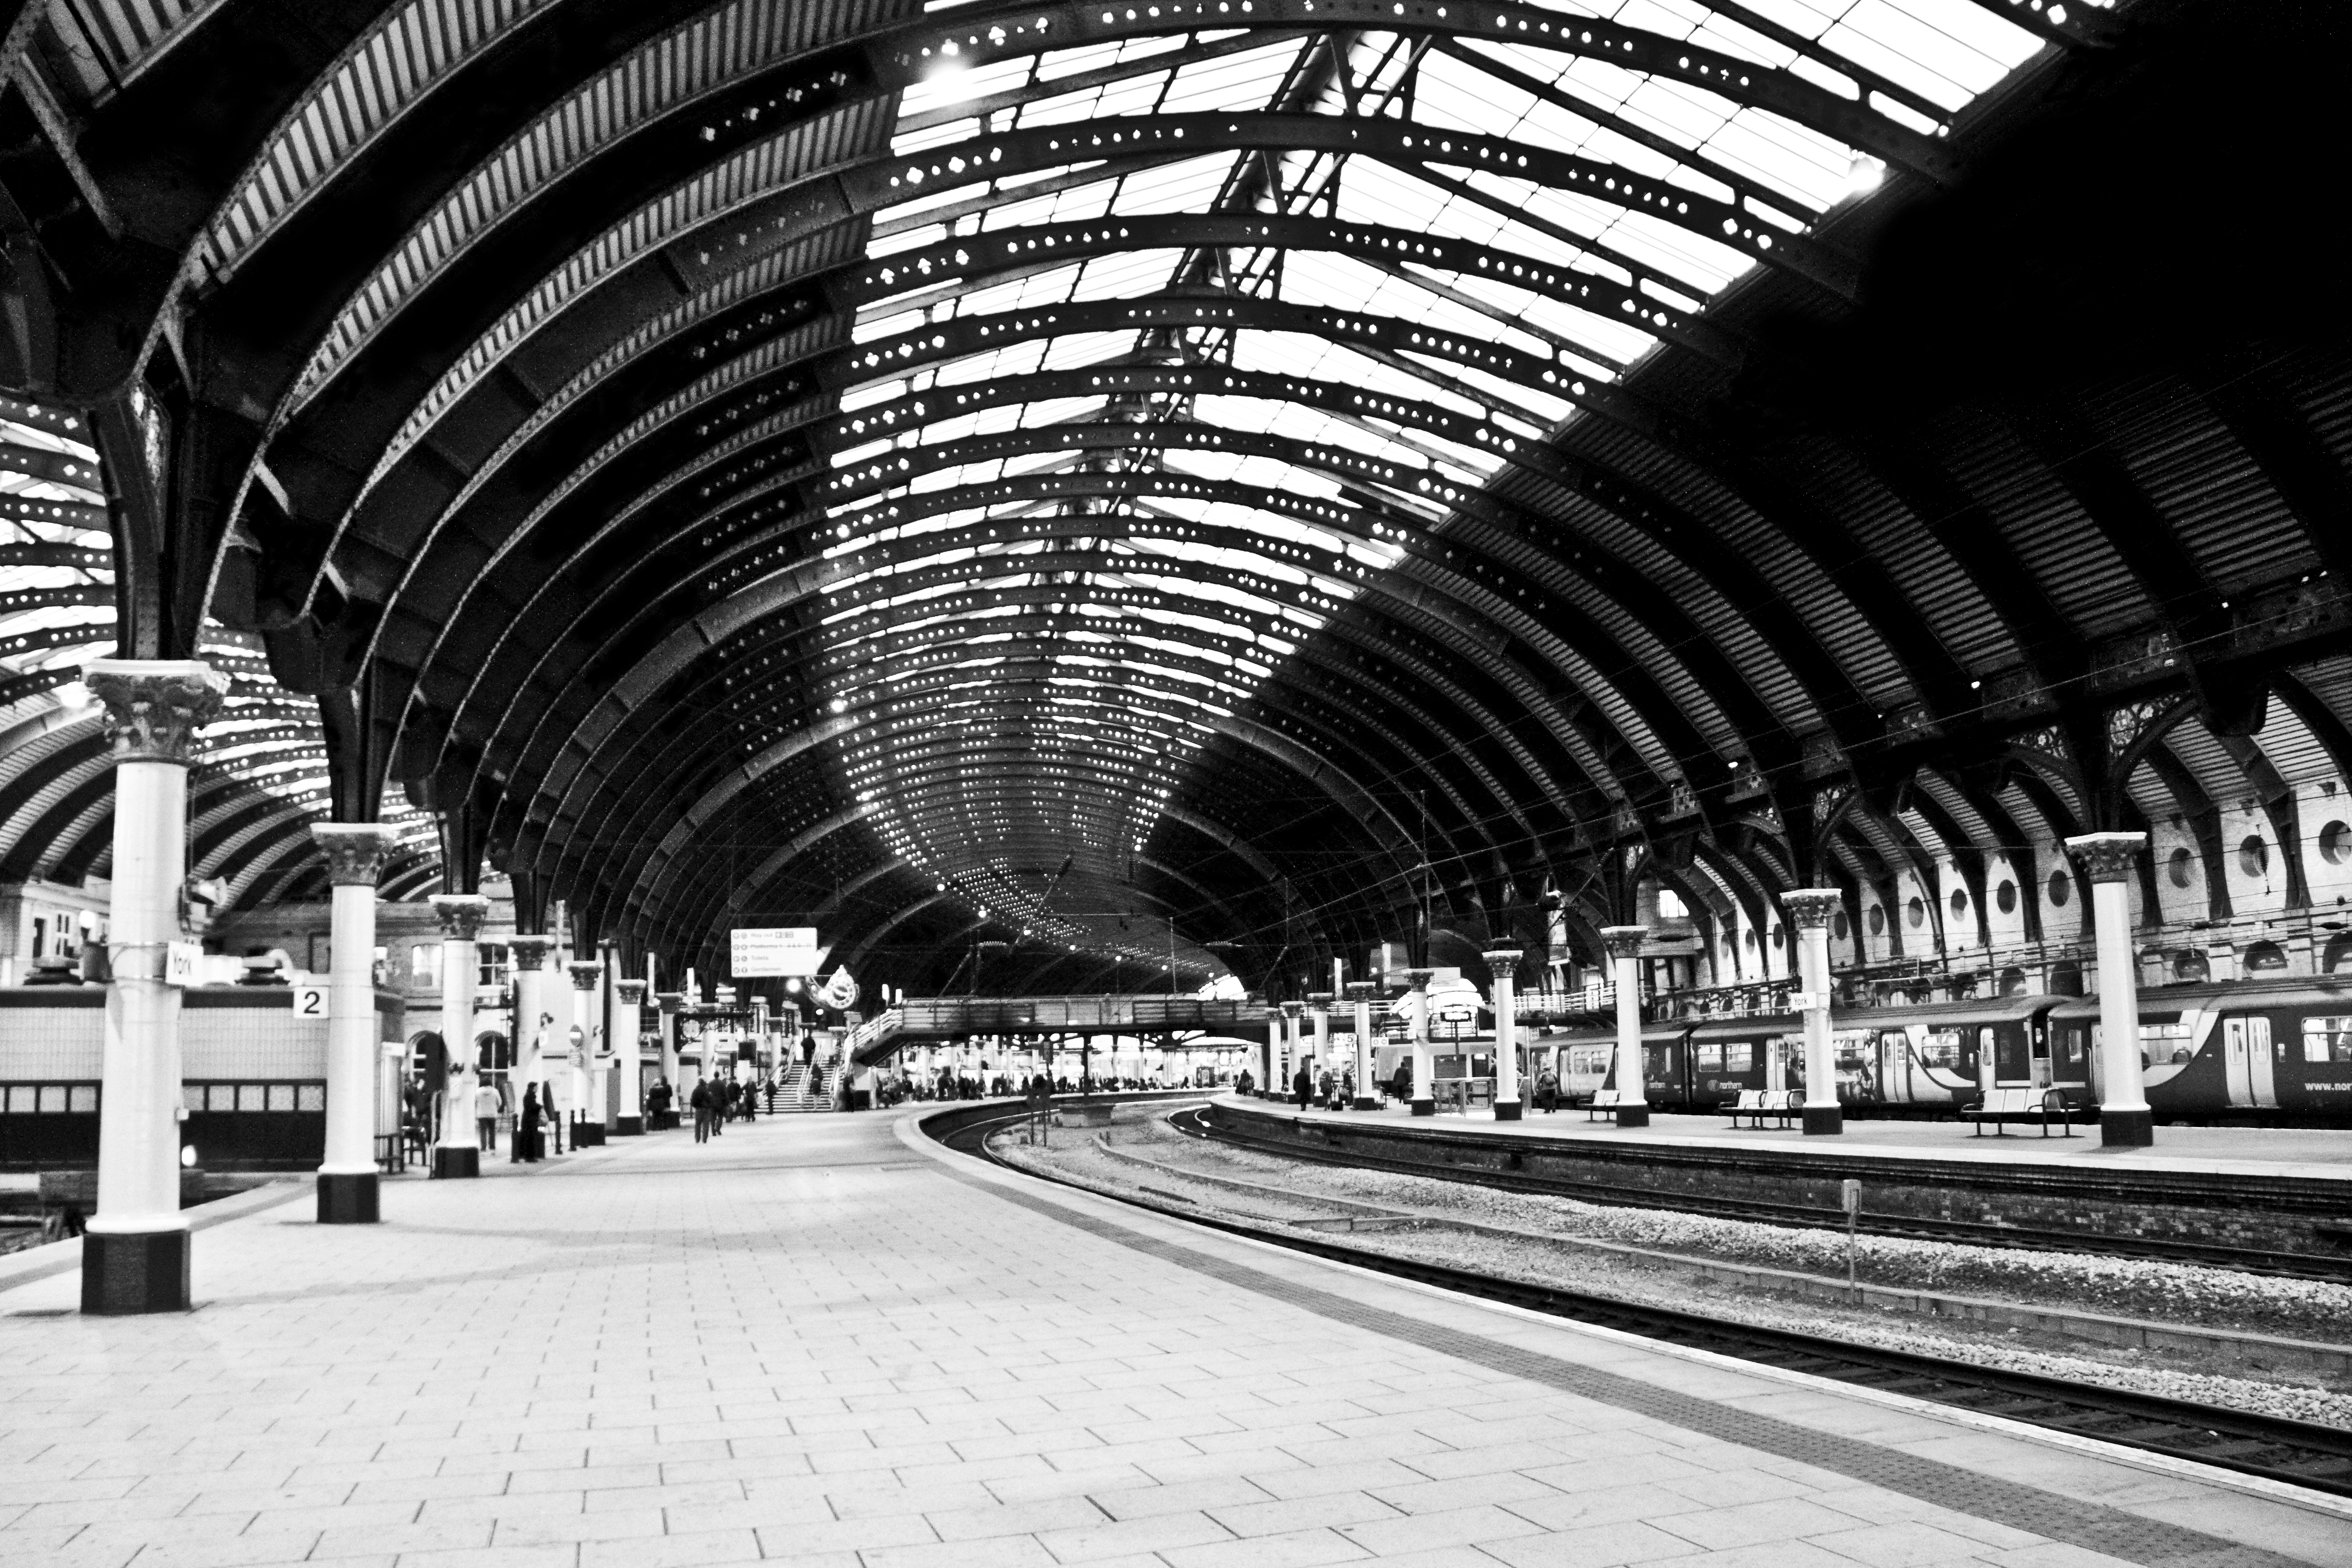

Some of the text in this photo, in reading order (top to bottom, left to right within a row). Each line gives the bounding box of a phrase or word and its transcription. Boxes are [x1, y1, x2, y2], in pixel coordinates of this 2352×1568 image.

[172, 950, 192, 976] York
[304, 991, 320, 1014] 2
[1793, 995, 1808, 1005] York
[1720, 1081, 1742, 1089] northern
[2305, 1083, 2352, 1091] www.nor
